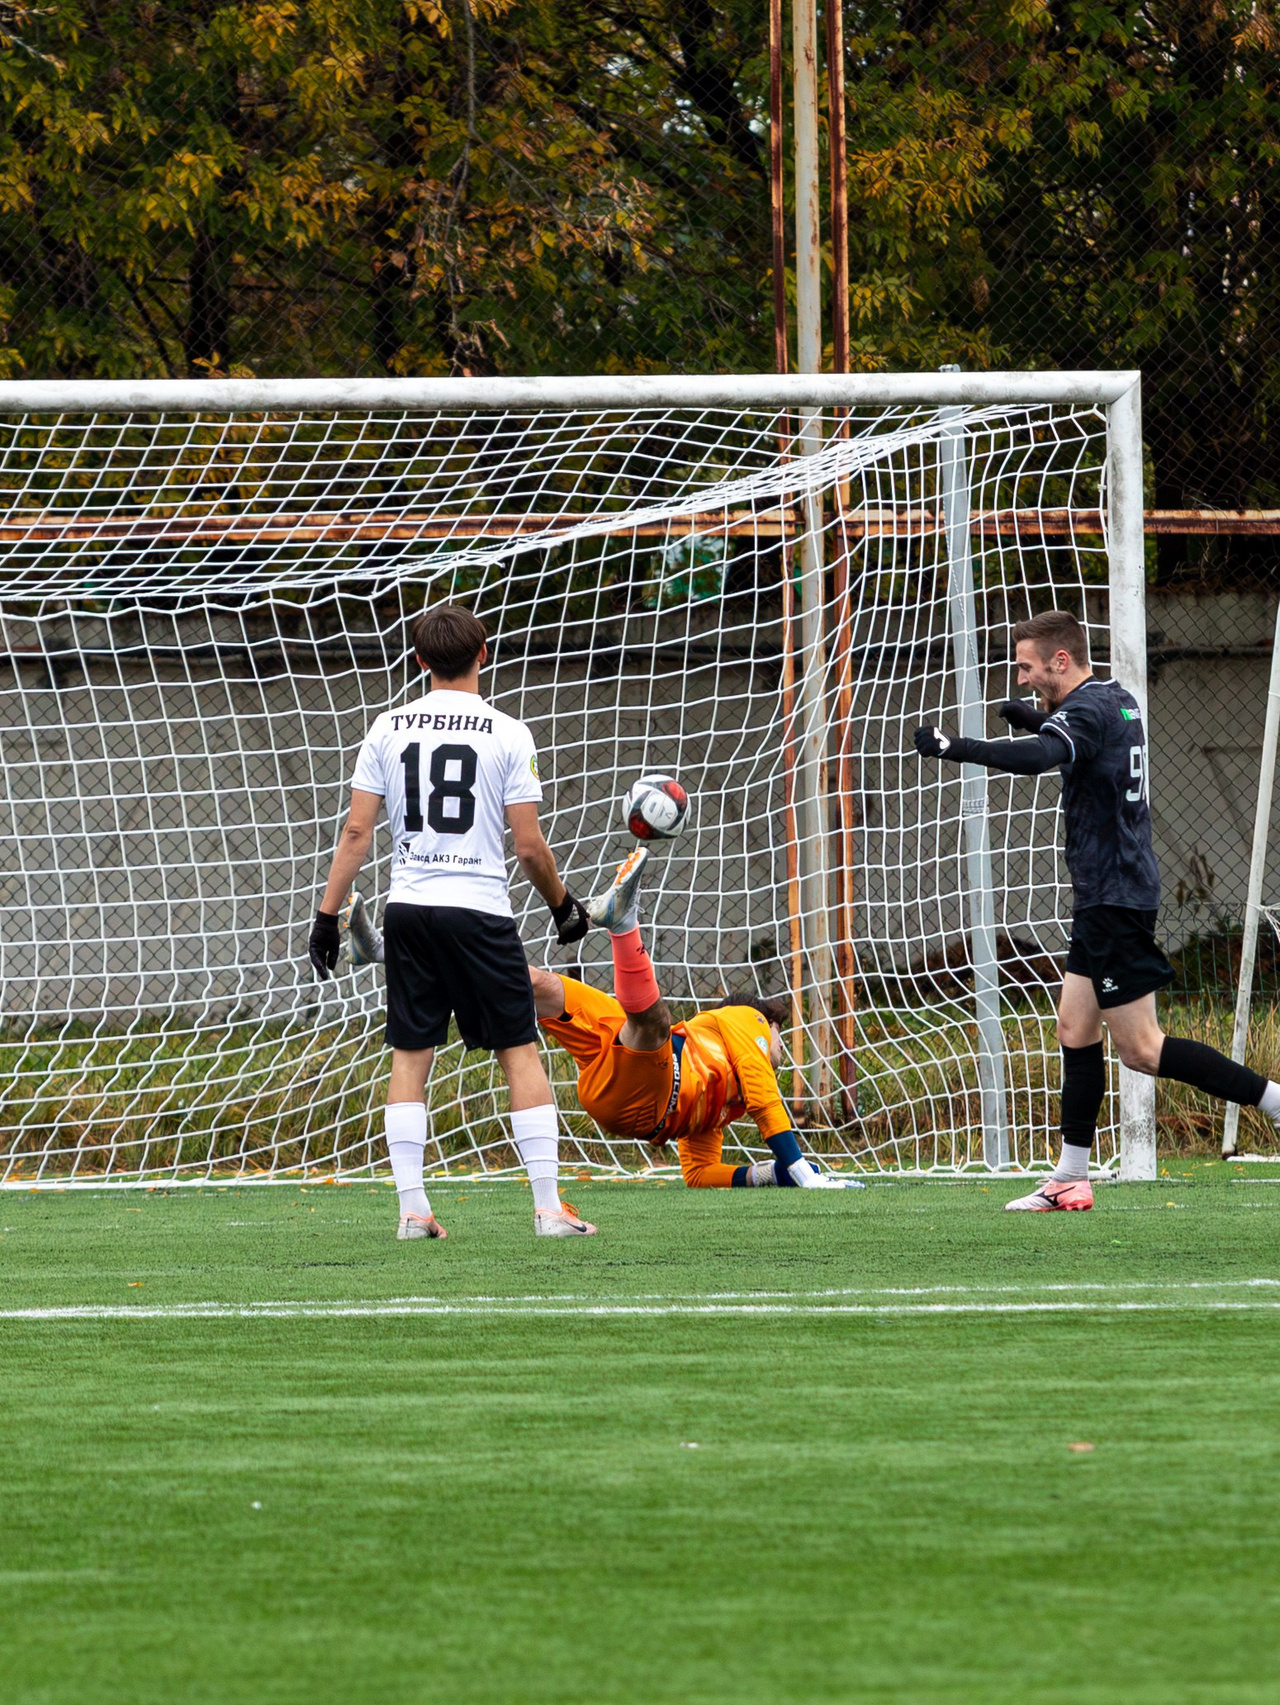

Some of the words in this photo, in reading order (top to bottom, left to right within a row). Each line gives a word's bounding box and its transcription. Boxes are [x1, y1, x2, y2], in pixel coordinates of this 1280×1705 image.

[391, 713, 493, 734] ТУРБИНА
[400, 742, 478, 835] 18
[452, 854, 482, 866] Гарант
[672, 1053, 681, 1080] PRO
